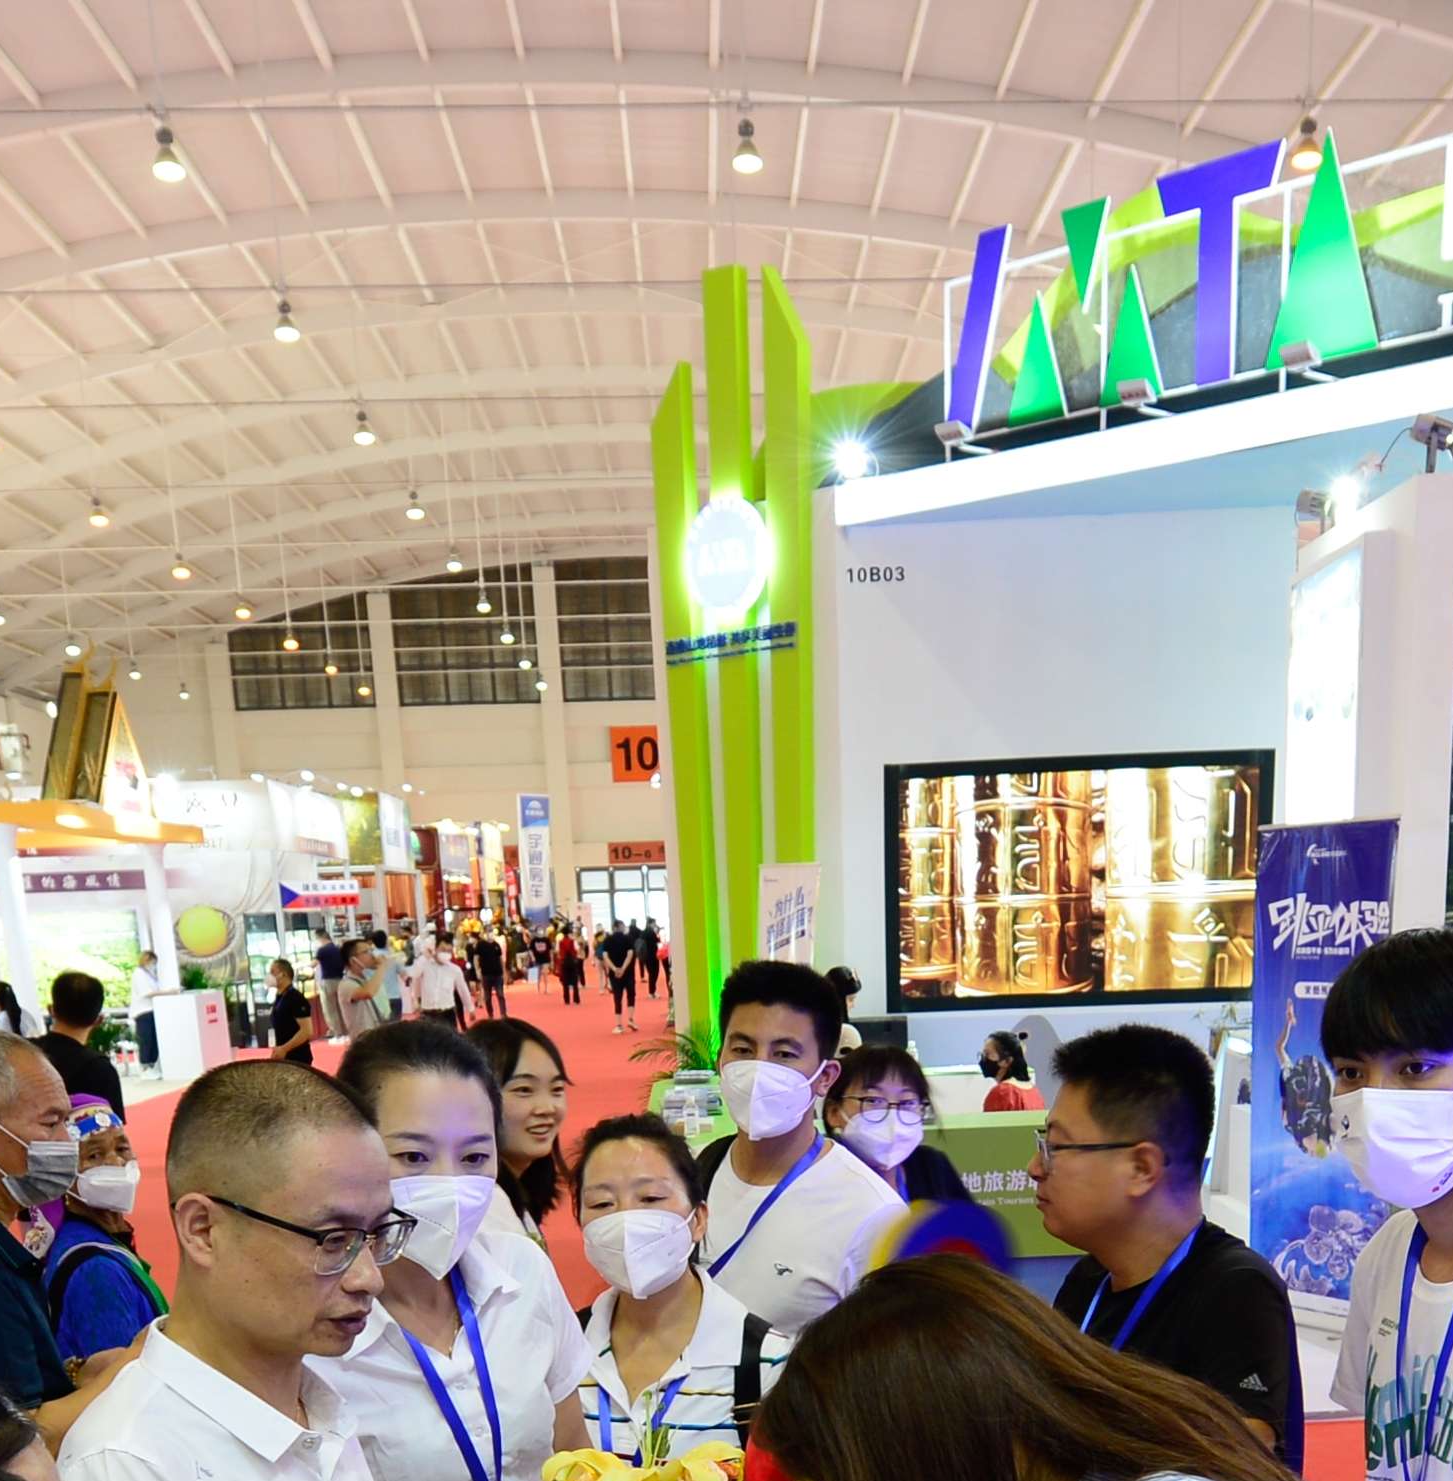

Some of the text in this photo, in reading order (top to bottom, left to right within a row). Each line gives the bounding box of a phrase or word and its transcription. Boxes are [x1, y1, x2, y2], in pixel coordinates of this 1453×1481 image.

[845, 565, 906, 585] 10B03
[615, 736, 659, 772] 10
[1267, 892, 1391, 960] 跳伞体验
